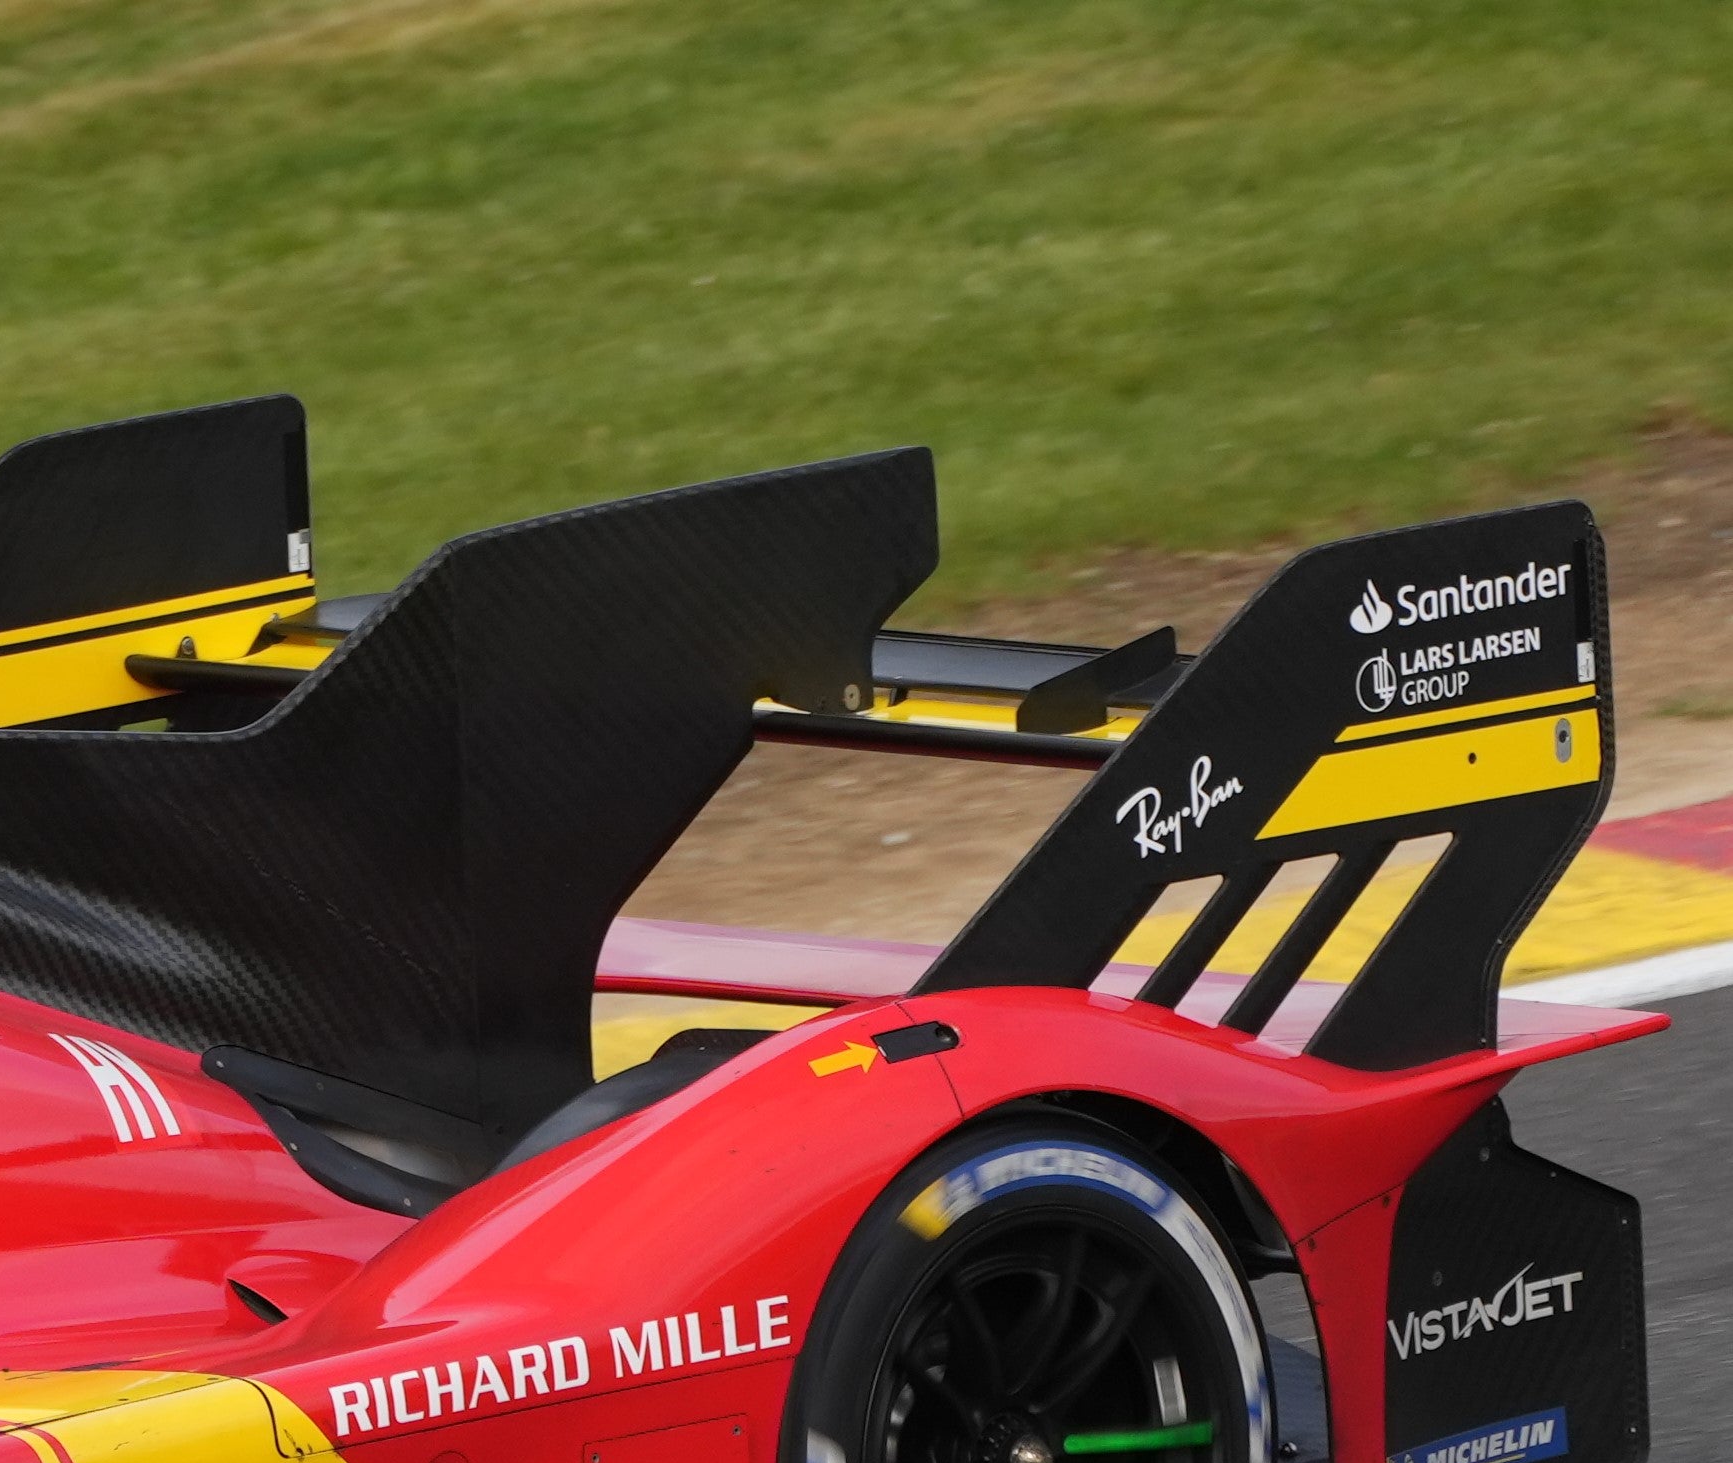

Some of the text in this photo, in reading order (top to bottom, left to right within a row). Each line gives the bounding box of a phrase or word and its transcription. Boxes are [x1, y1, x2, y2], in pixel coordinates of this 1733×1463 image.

[1397, 562, 1571, 627] Santander
[1400, 627, 1541, 677] LARS LARSEN
[1401, 670, 1471, 707] GROUP
[328, 1294, 792, 1437] RICHARD MILLE
